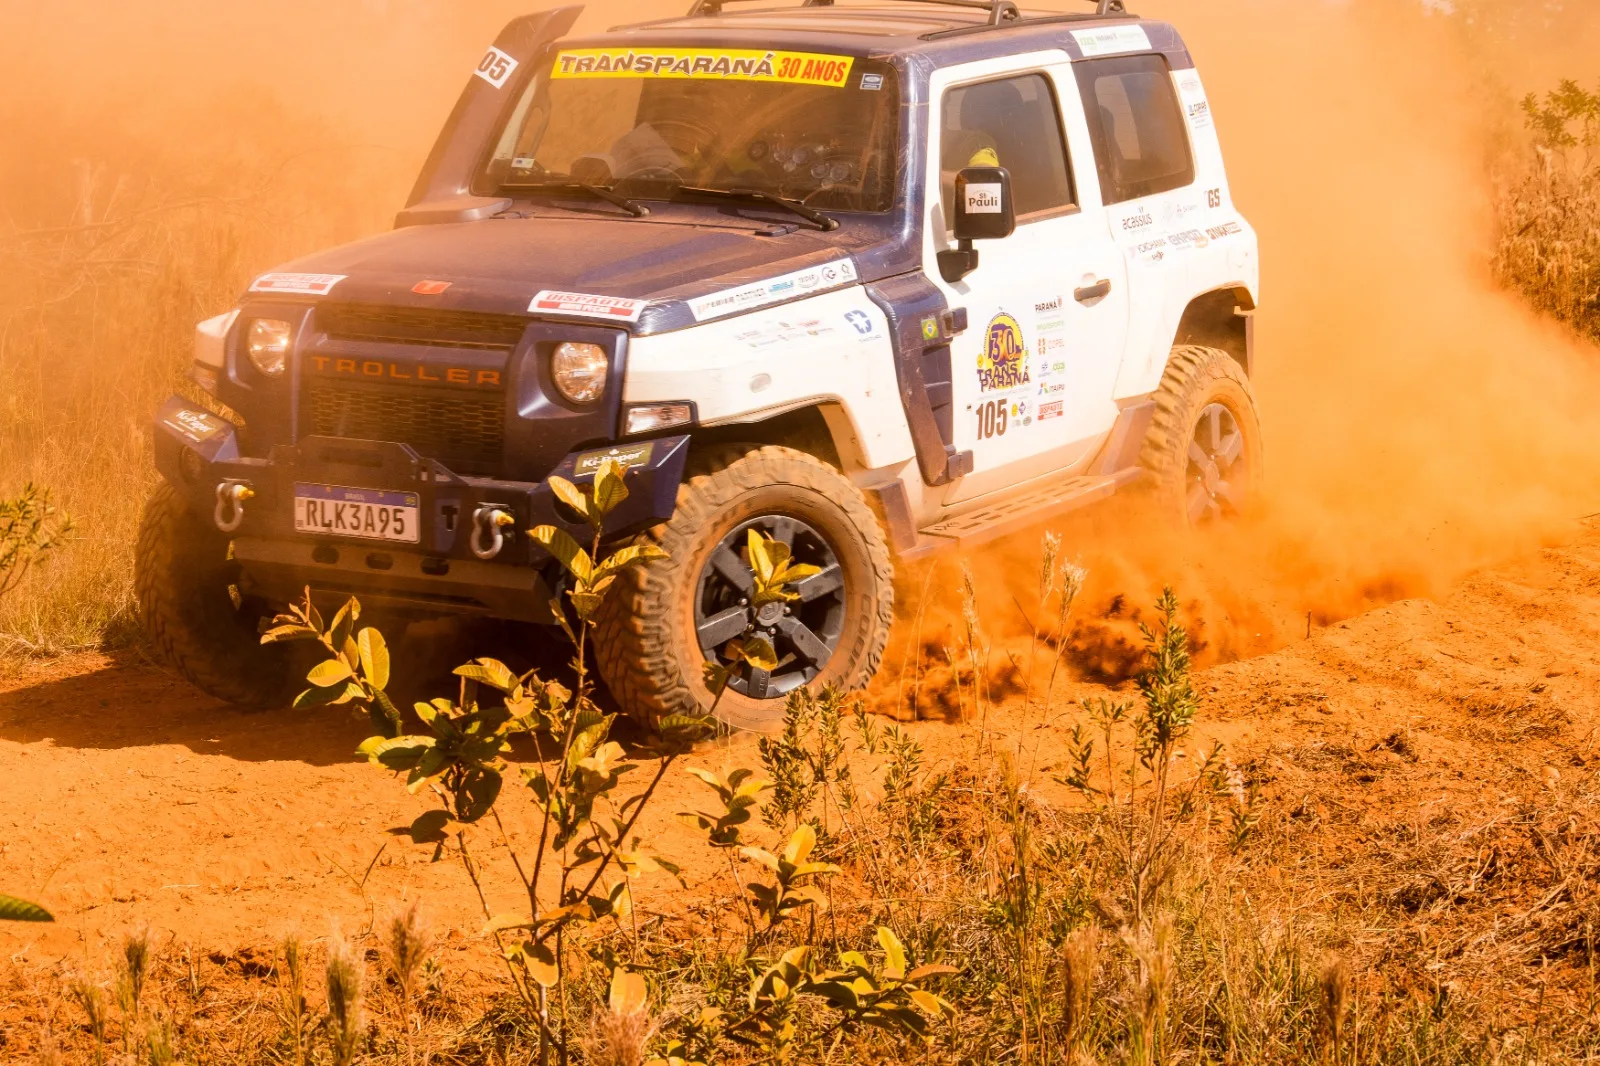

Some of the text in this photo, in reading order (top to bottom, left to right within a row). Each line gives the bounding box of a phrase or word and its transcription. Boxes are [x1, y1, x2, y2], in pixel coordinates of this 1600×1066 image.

[559, 51, 847, 83] TRANSPARANÁ 30 ANOS
[968, 197, 998, 206] Pauli
[1122, 213, 1152, 230] acassius
[545, 293, 635, 308] DISPAUTO
[1035, 300, 1057, 312] PARANÁ
[312, 356, 500, 385] TROLLER
[977, 362, 1017, 382] TRANS
[981, 367, 1031, 392] PARANÁ
[976, 398, 1007, 440] 105
[306, 500, 405, 535] RLK3A95
